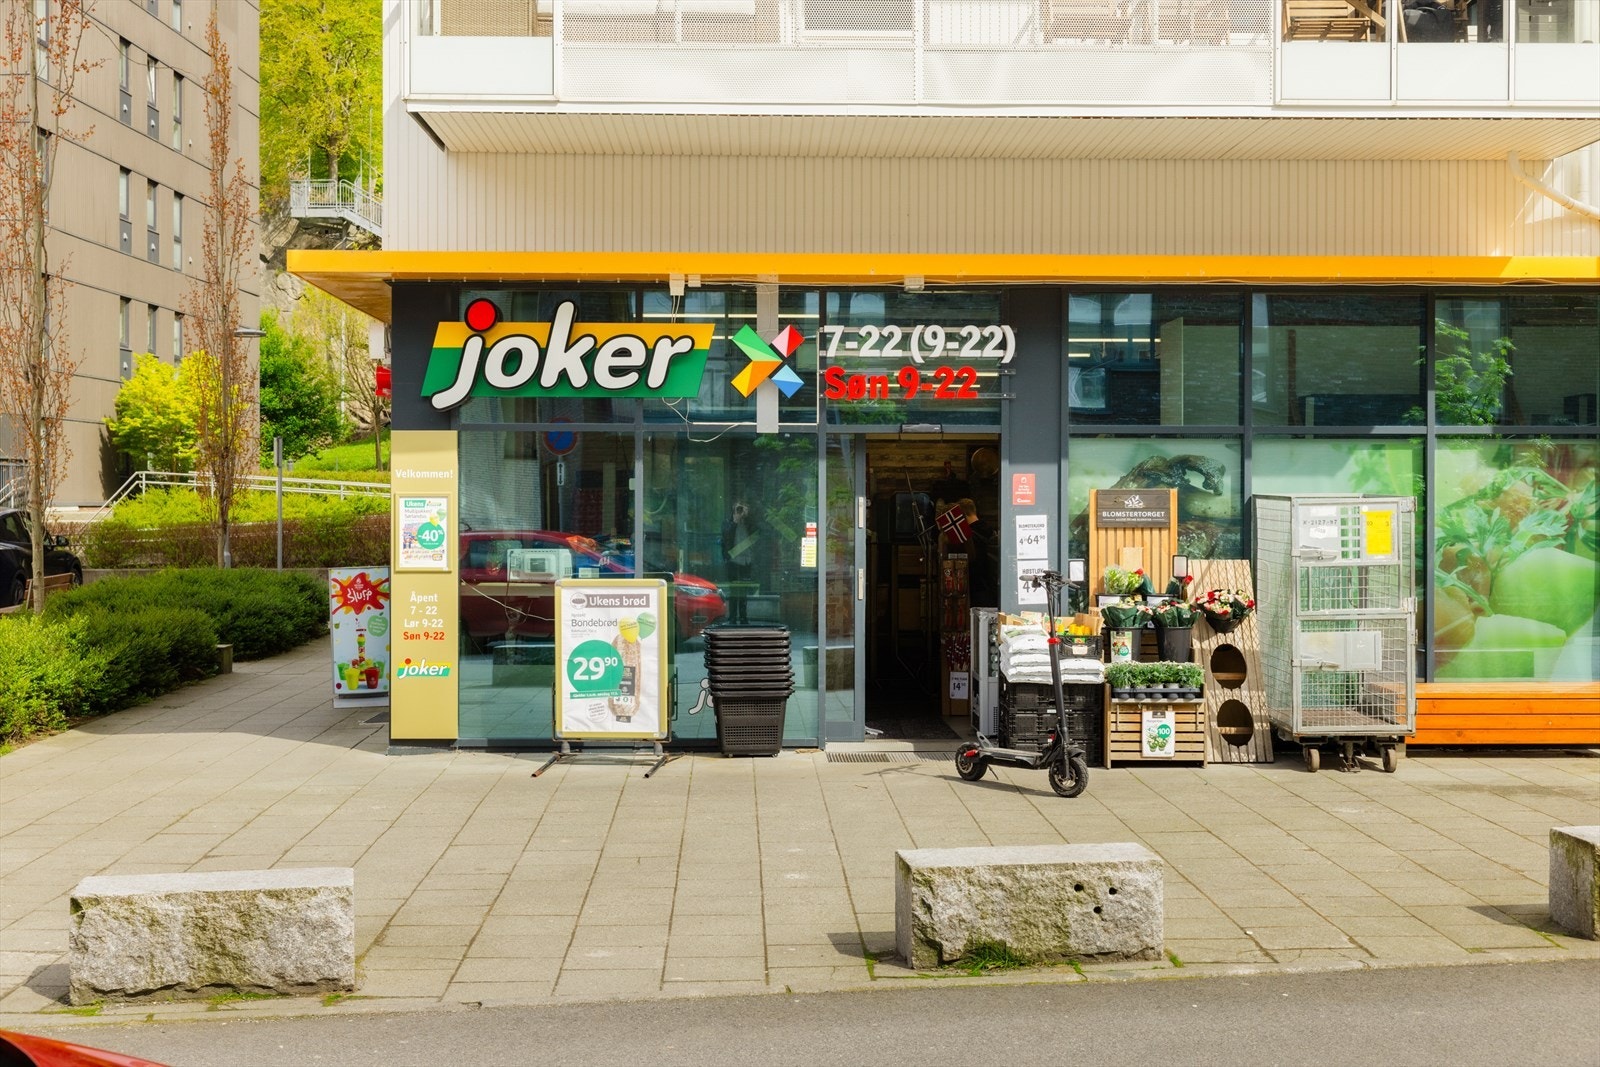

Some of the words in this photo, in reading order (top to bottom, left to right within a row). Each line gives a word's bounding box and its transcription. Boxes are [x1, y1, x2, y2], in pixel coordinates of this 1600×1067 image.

[824, 324, 903, 358] 7-22
[910, 324, 1016, 364] (9-22)
[431, 298, 695, 411] joker
[824, 366, 889, 400] Søn
[897, 366, 978, 399] 9-22
[395, 469, 453, 478] Velkommen!
[410, 591, 438, 603] Åpent
[589, 596, 620, 606] Ukens
[622, 596, 646, 606] brød
[410, 606, 416, 615] 7
[425, 606, 437, 615] 22
[404, 619, 419, 628] Lør
[422, 619, 443, 628] 9-22
[571, 619, 618, 627] Bondebrød
[403, 631, 421, 641] Søn
[423, 631, 445, 641] 9-22
[398, 658, 448, 679] joker
[1158, 727, 1170, 735] 100
